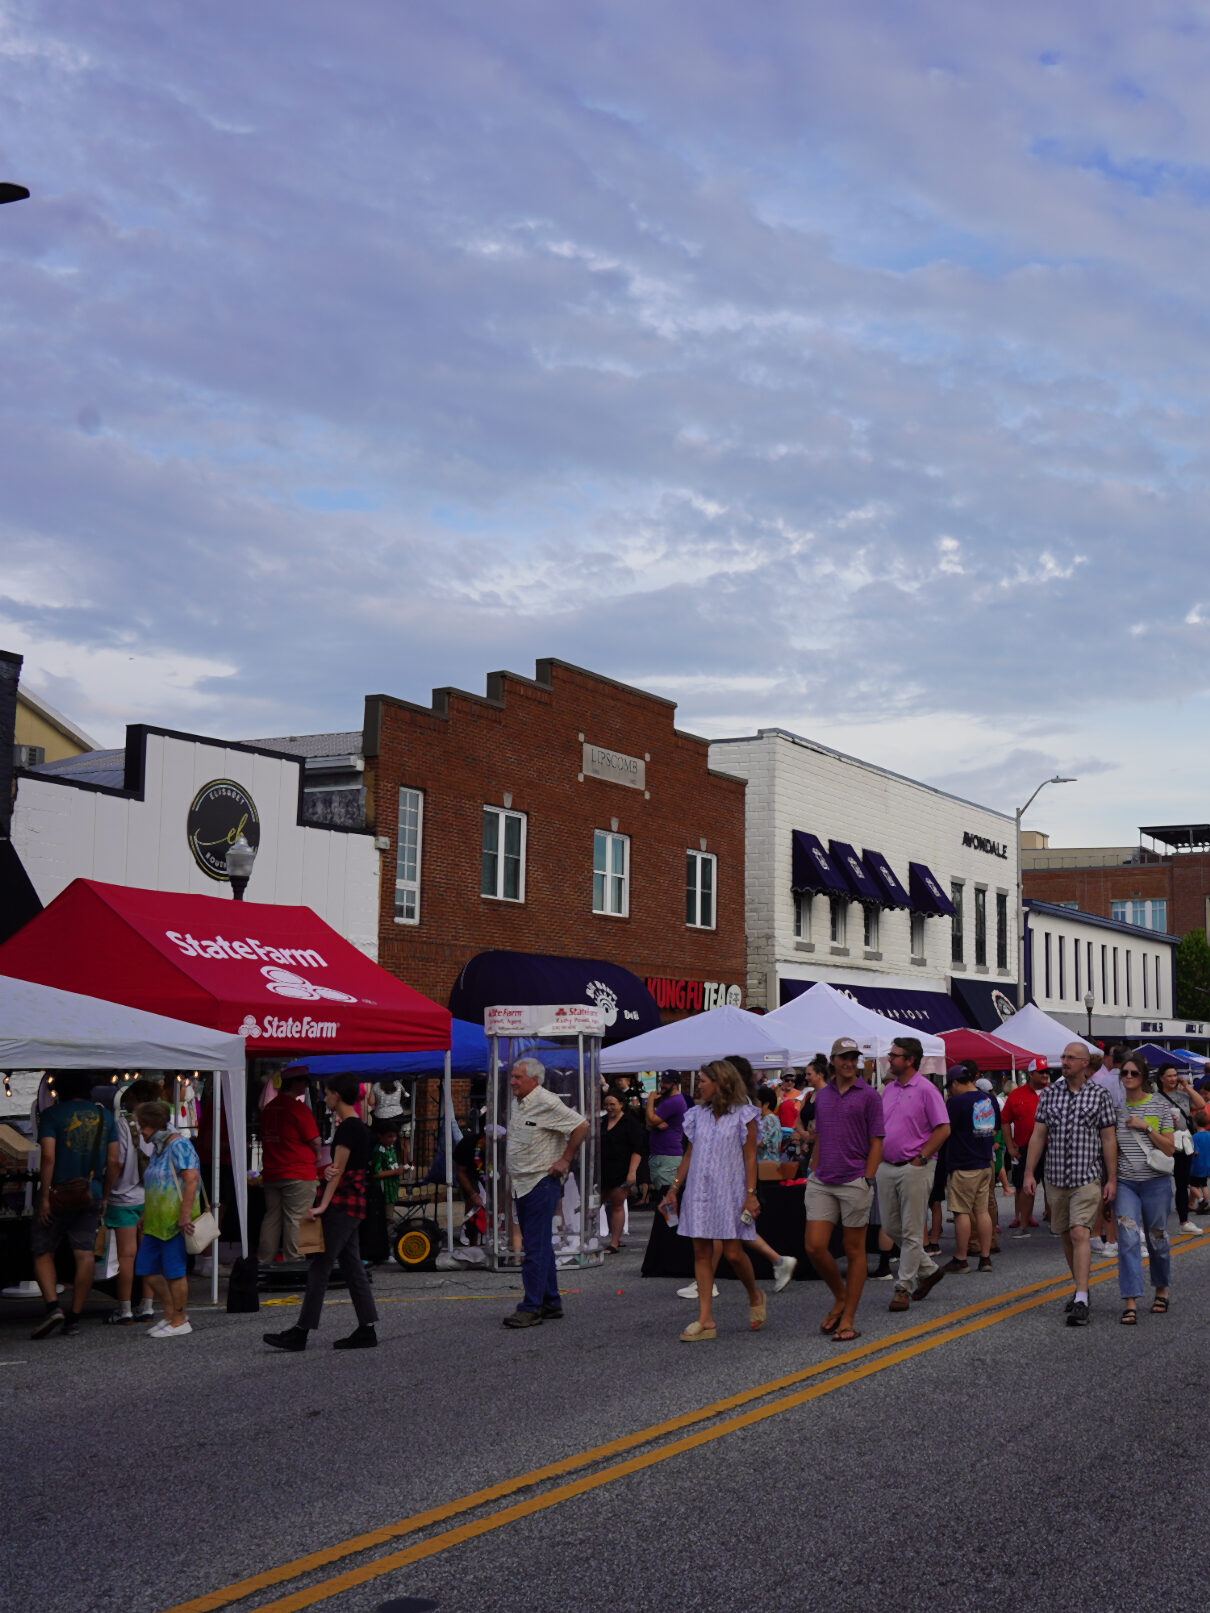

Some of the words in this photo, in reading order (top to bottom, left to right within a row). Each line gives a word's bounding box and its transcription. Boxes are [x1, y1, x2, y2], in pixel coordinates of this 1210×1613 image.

[591, 749, 638, 775] LIPSCOMB
[962, 831, 1008, 860] AVONDALE
[703, 981, 726, 1011] TEA
